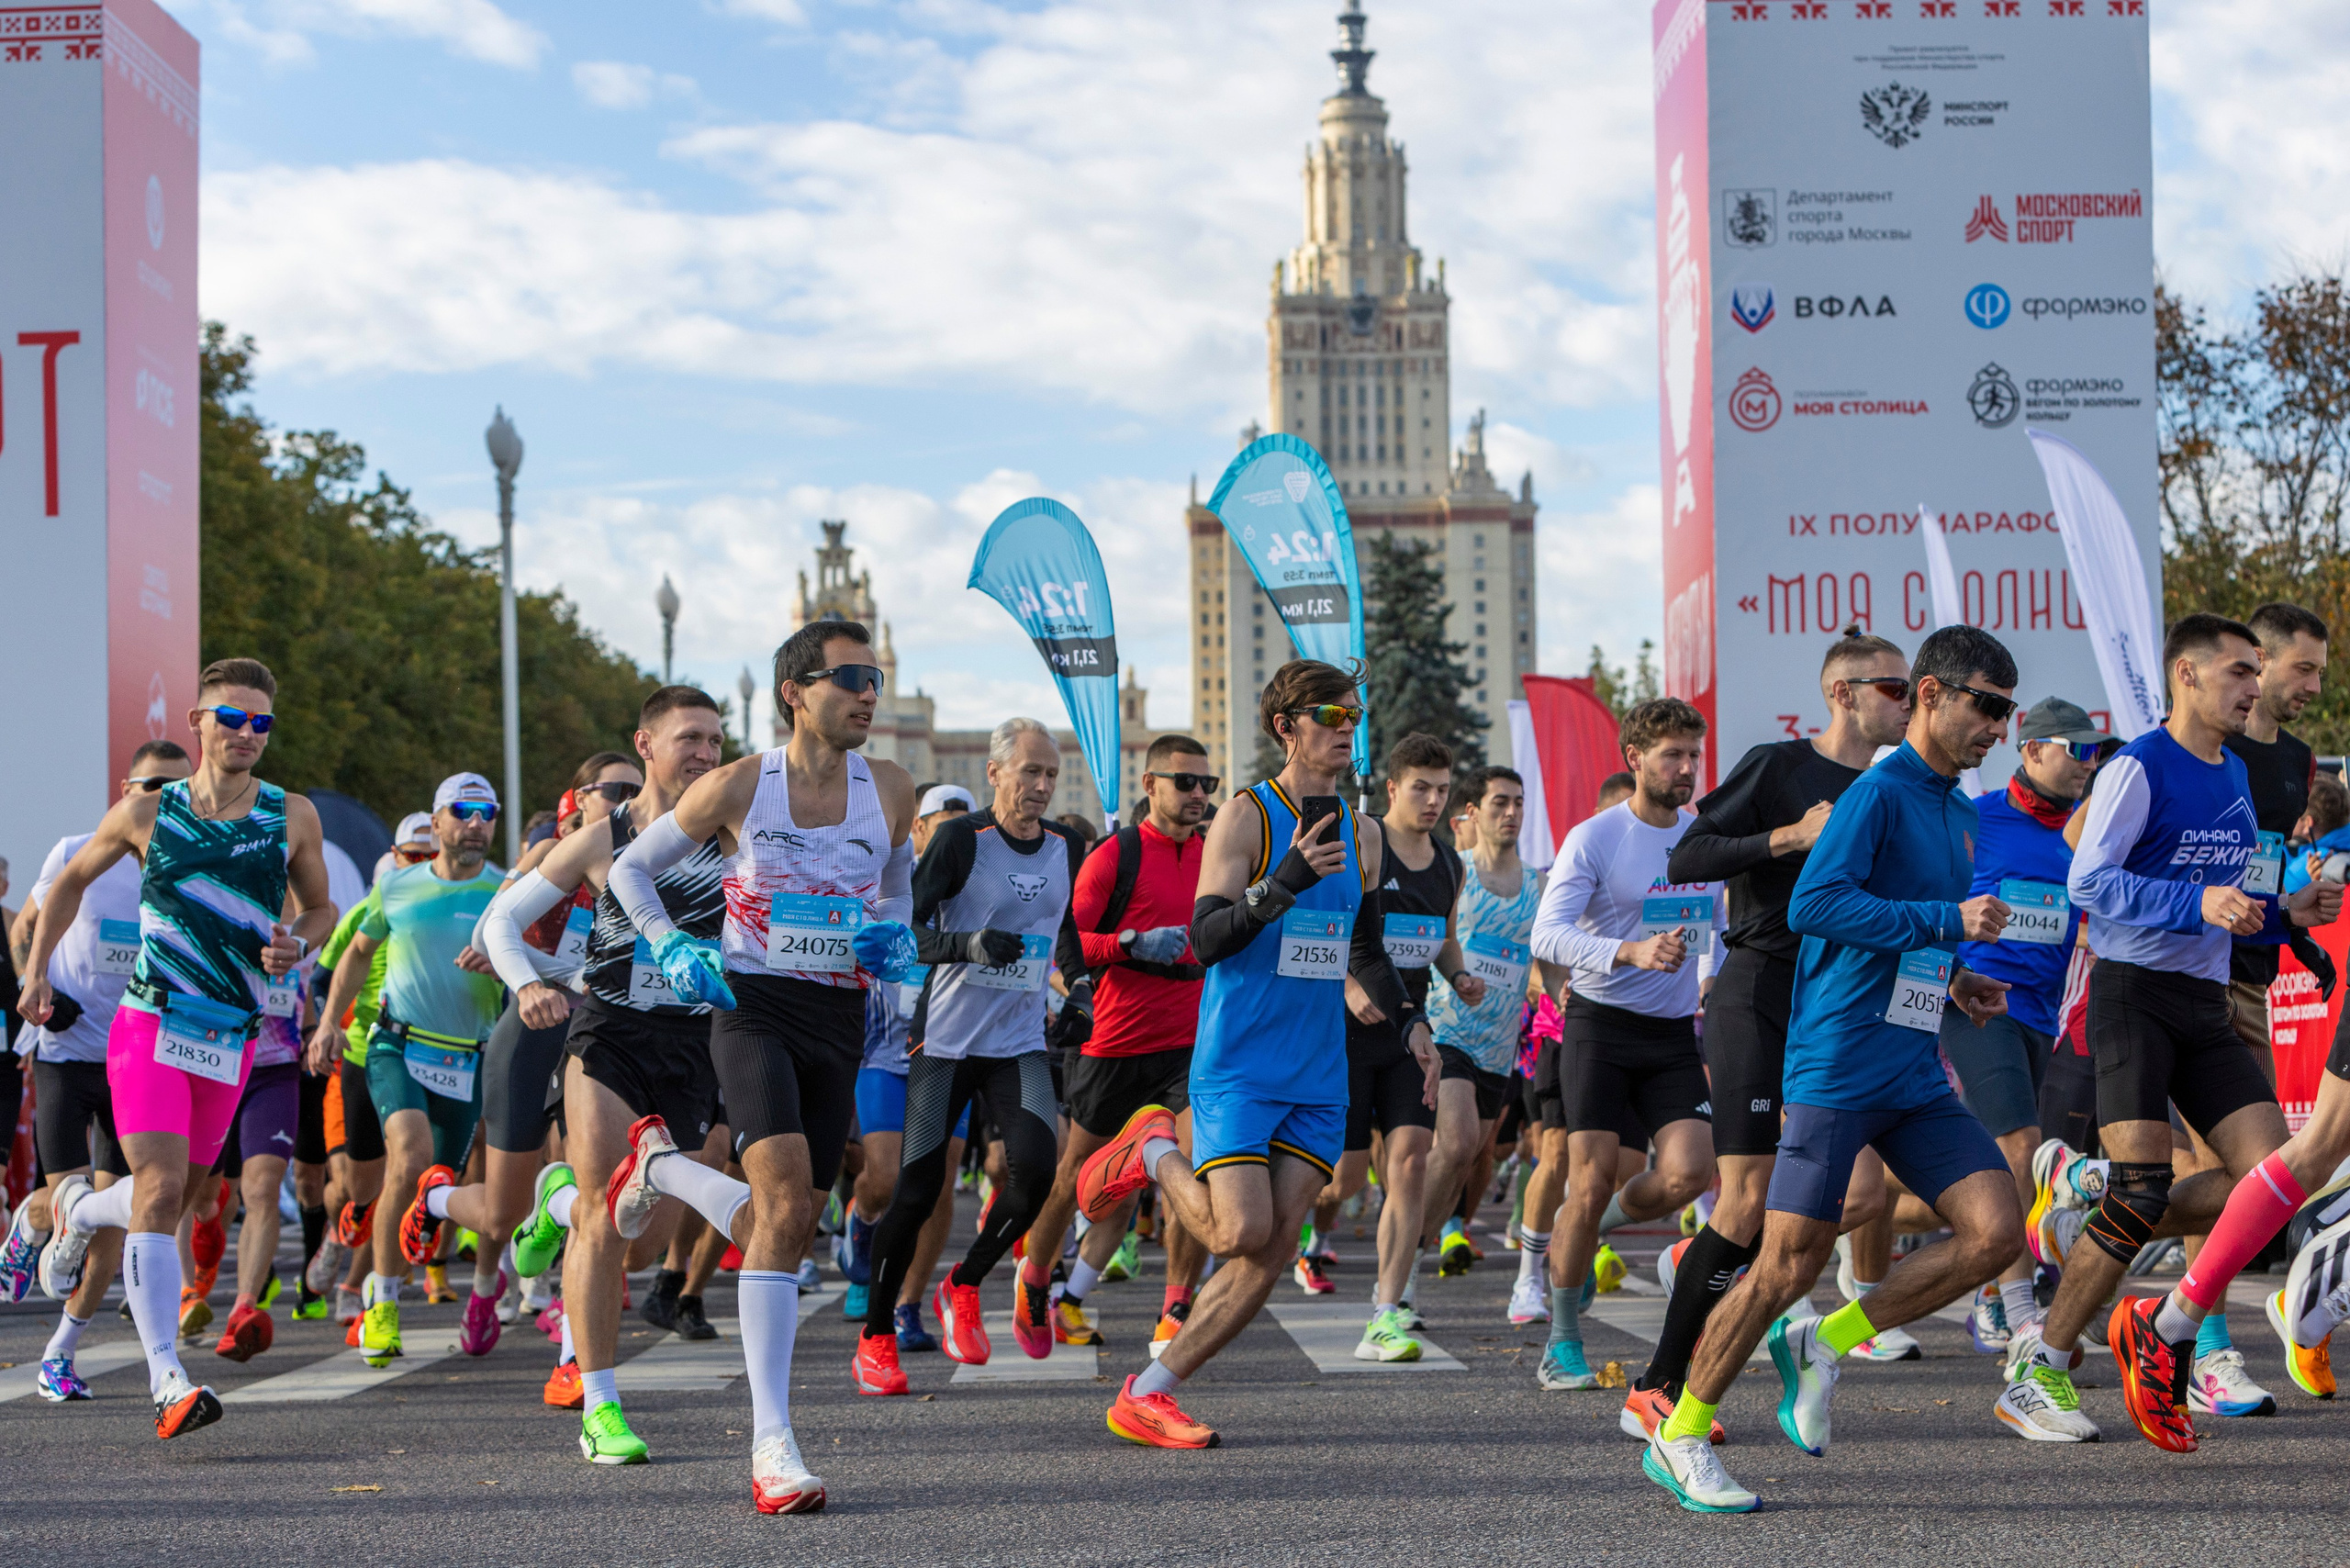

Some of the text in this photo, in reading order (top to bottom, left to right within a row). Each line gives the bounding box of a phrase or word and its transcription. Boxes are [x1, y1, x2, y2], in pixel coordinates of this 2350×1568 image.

[1943, 101, 2009, 112] МИНСПОРТ
[1943, 117, 1995, 126] РОССИИ
[1786, 190, 1893, 207] Департамент
[2016, 188, 2143, 218] МОСКОВСКИЙ
[1787, 209, 1843, 225] спорта
[1787, 228, 1912, 246] города Москвы
[2016, 220, 2075, 243] СПОРТ
[1795, 296, 1897, 319] ВФЛА
[2022, 297, 2146, 320] фармэко
[2026, 378, 2123, 396] фармэко
[1794, 400, 1929, 416] МОЯ СТОЛИЦА
[0, 331, 80, 516] Т
[1789, 511, 2060, 536] IX ПОЛУАРАФО
[1903, 569, 2087, 632] СОЛИЦ
[753, 830, 805, 846] ARC
[2179, 830, 2240, 843] ДИНАМО
[2169, 846, 2255, 866] БЕЖИТ
[2008, 912, 2059, 931] 21044
[780, 935, 848, 956] 24075
[1291, 946, 1337, 964] 21536
[1389, 943, 1430, 958] 23932
[106, 948, 138, 964] 207
[1474, 959, 1507, 979] 21181
[2272, 971, 2320, 1005] фармэк
[165, 1039, 220, 1067] 21830
